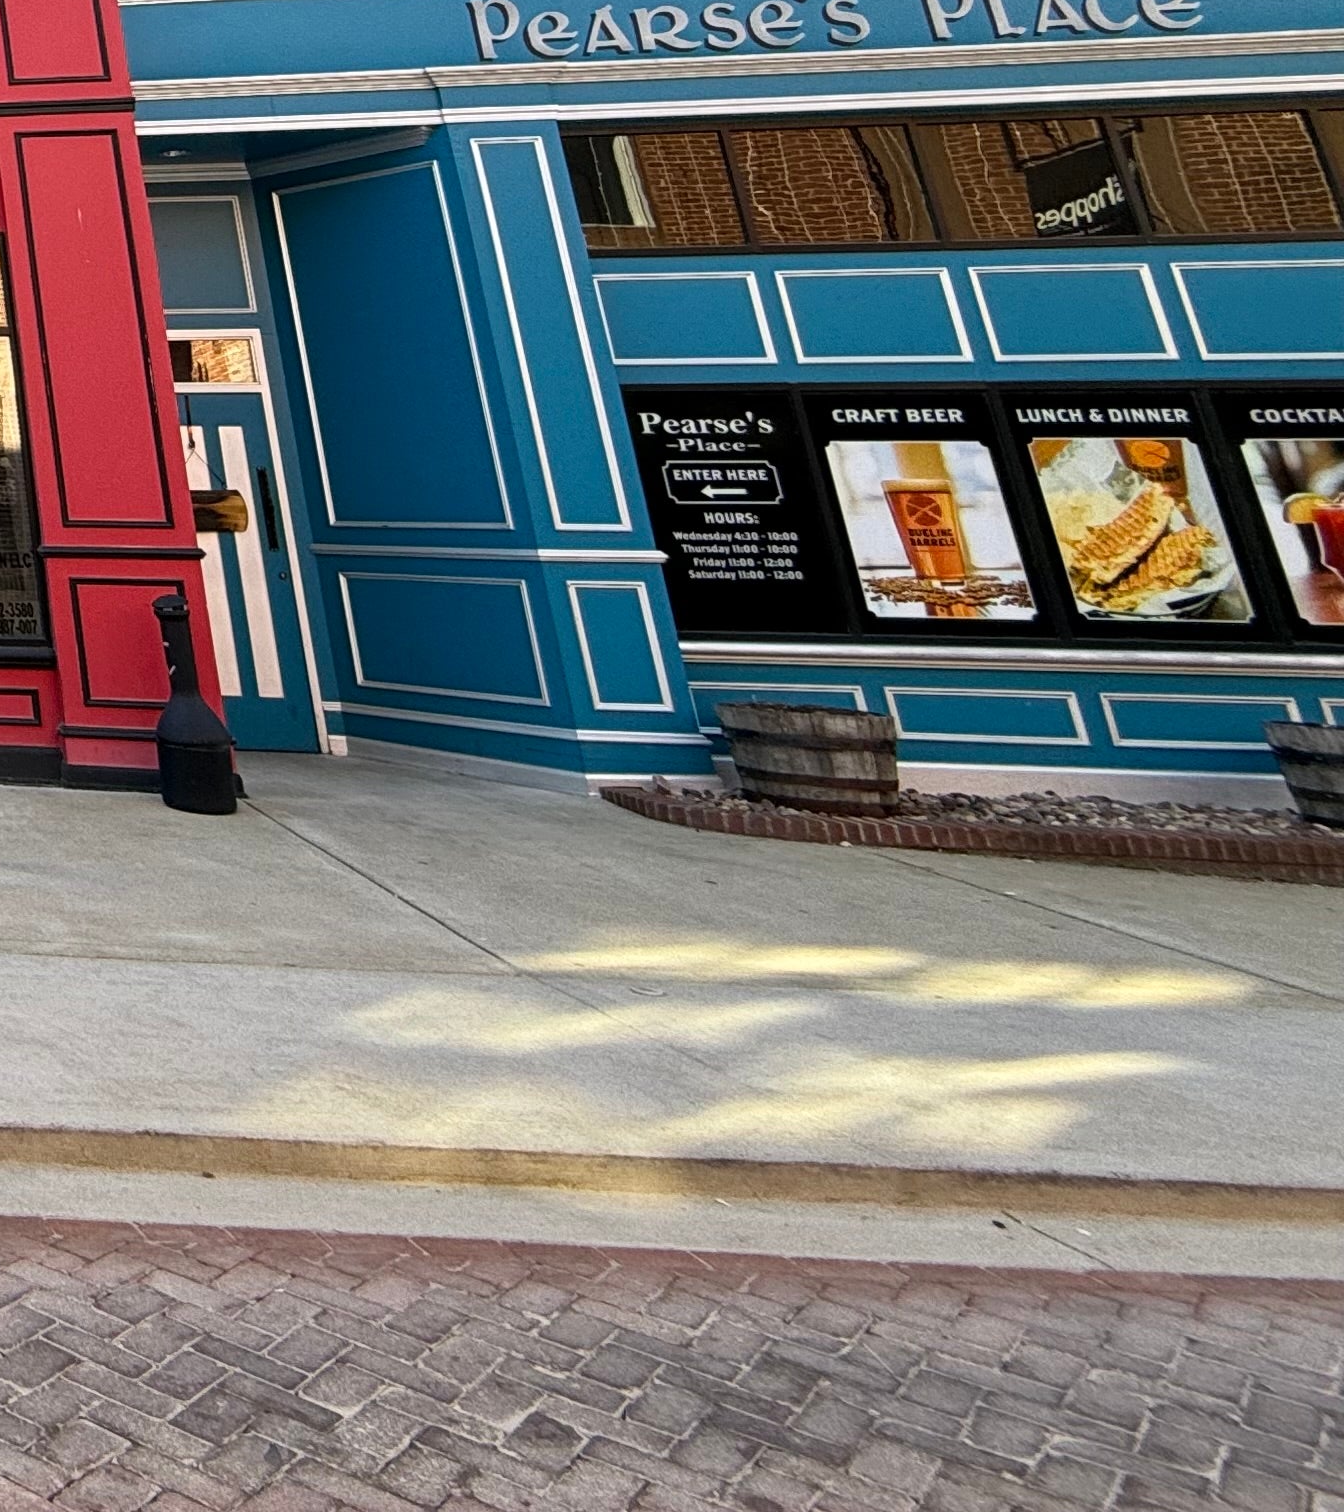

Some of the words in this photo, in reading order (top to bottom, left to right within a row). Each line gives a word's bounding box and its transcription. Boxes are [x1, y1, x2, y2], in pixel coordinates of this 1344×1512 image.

[832, 409, 899, 423] CRAFT
[905, 409, 965, 423] BEER
[1015, 409, 1085, 423] LUNCH
[1088, 409, 1105, 423] &
[1107, 409, 1192, 423] DINNER
[1249, 408, 1344, 423] COCKTA
[637, 411, 774, 435] Pearse's
[672, 469, 722, 481] ENTER
[726, 469, 769, 481] HERE
[704, 512, 760, 524] HOURS:
[673, 531, 732, 542] Wednesday
[681, 544, 730, 554] Thursday
[693, 557, 727, 568] Friday
[688, 570, 736, 580] Saturday
